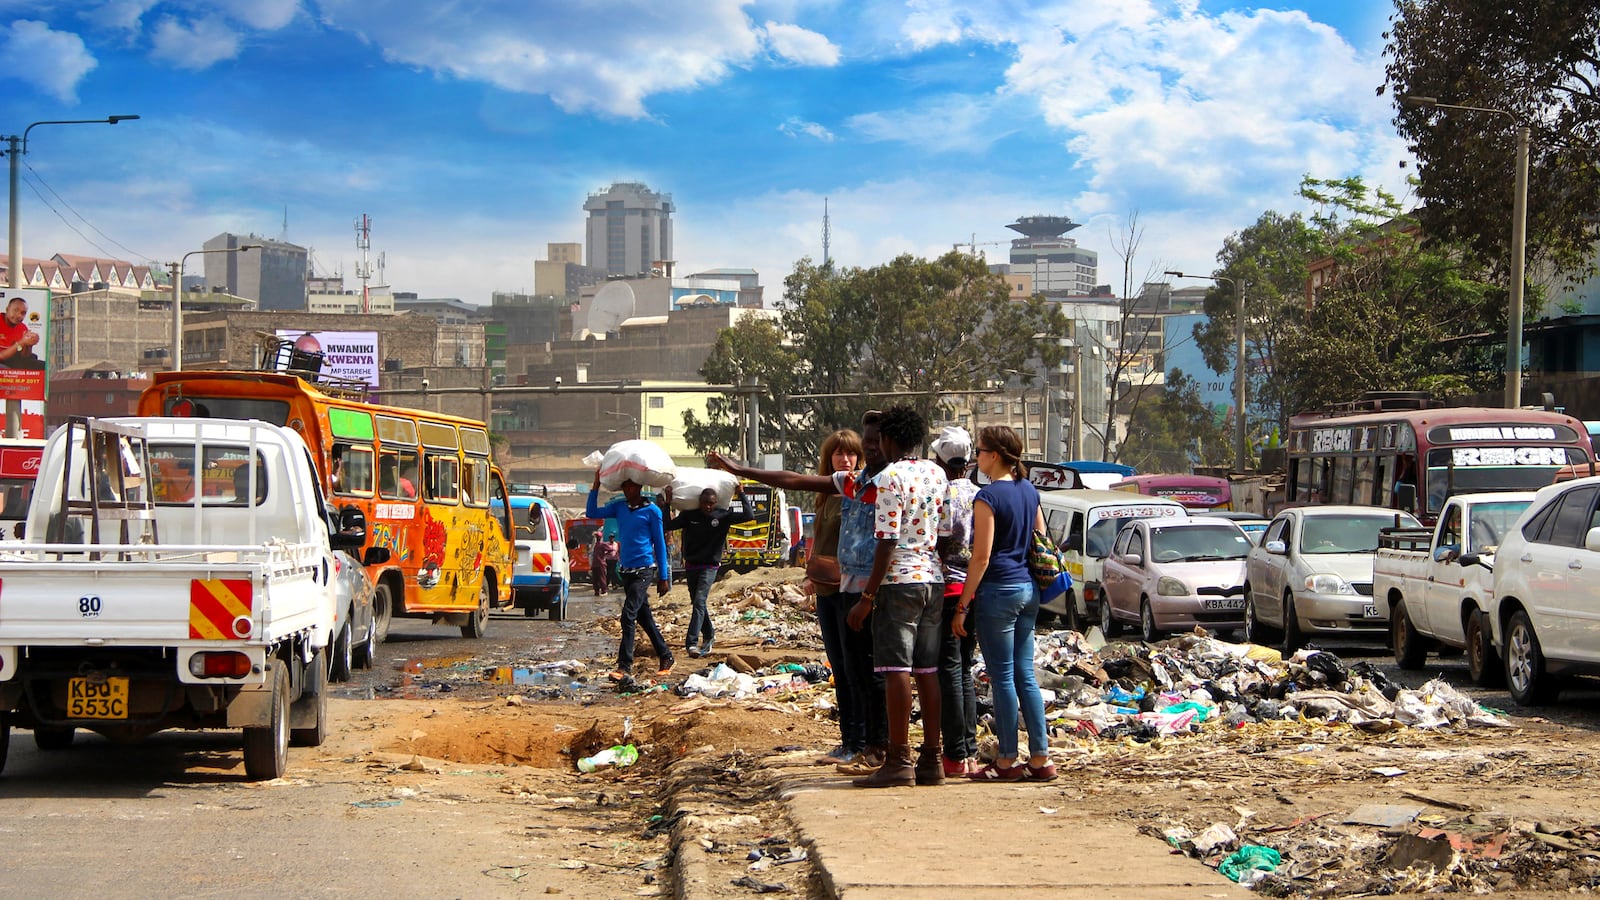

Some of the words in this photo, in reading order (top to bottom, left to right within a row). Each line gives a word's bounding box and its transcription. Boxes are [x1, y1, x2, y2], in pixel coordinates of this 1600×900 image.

[327, 344, 374, 353] MWANIKI
[328, 355, 374, 365] KWENYA
[1207, 382, 1224, 391] YOU
[1452, 447, 1567, 465] REIGN
[79, 597, 101, 613] 80
[71, 681, 111, 698] KBQ
[71, 699, 123, 716] 553C
